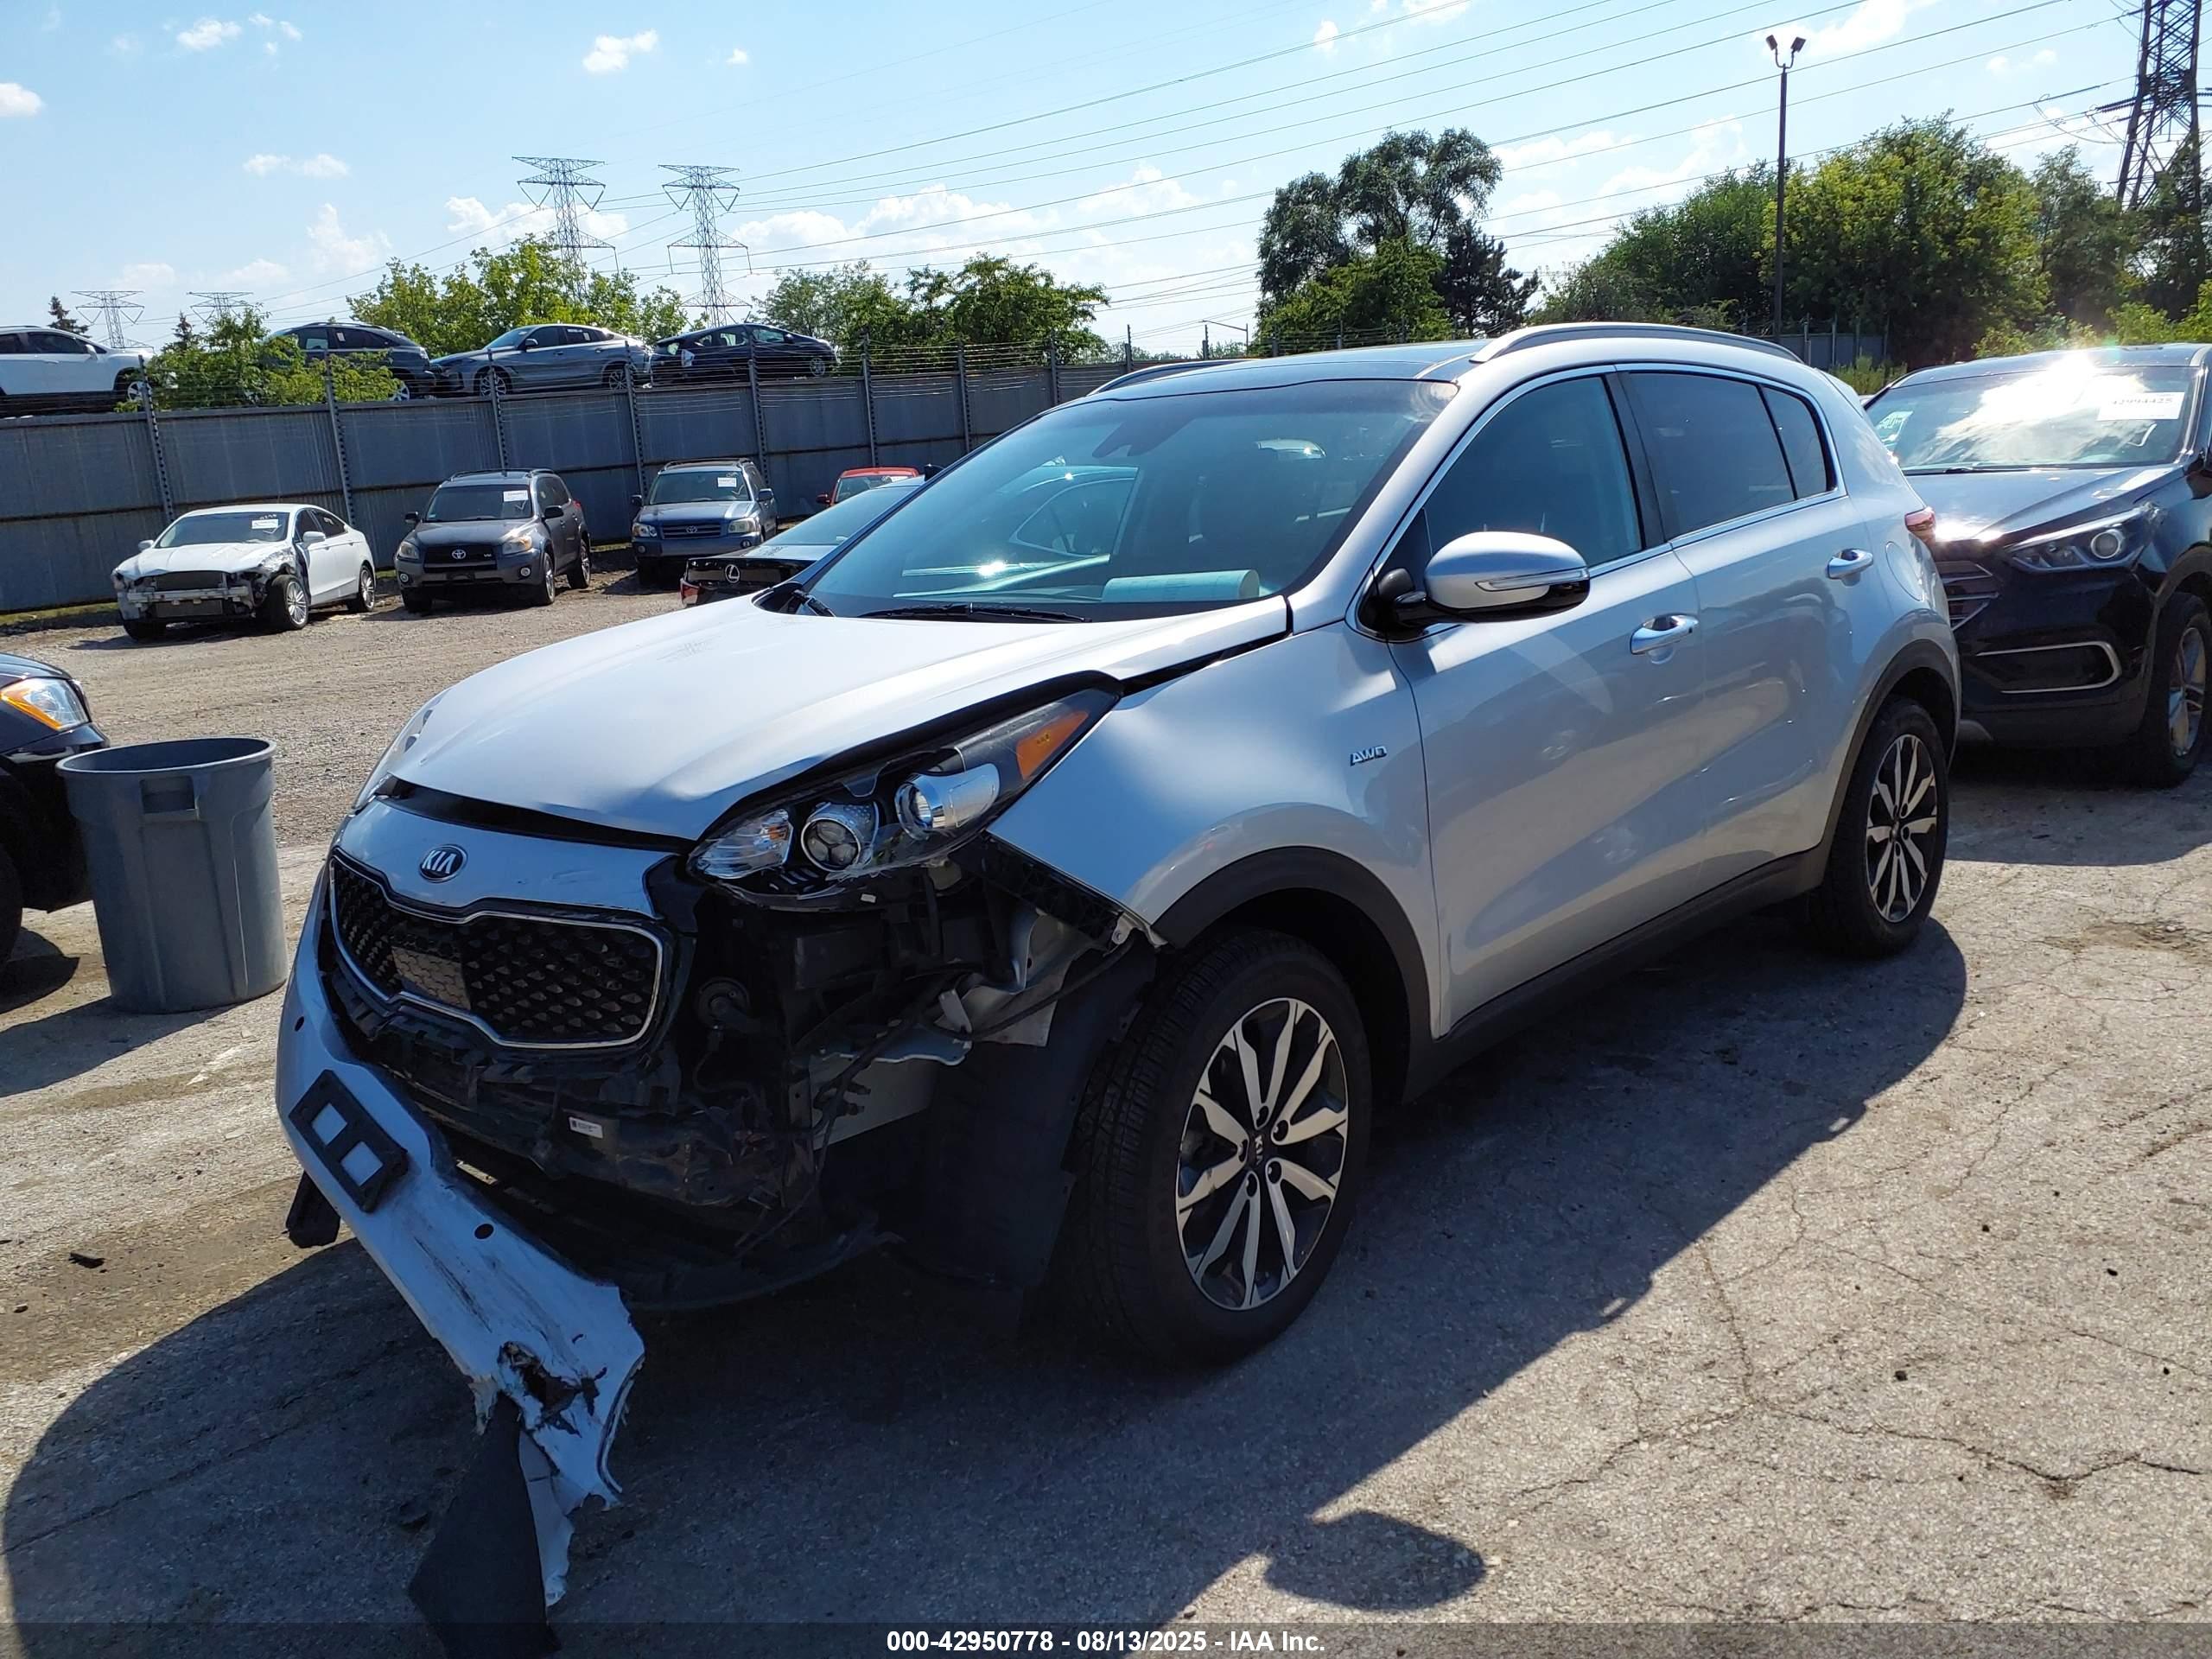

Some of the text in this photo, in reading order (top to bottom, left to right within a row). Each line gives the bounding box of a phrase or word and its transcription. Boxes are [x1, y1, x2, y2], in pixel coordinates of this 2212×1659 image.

[1351, 746, 1388, 766] AWD
[422, 849, 457, 874] KIA
[1255, 1135, 1263, 1166] KIA
